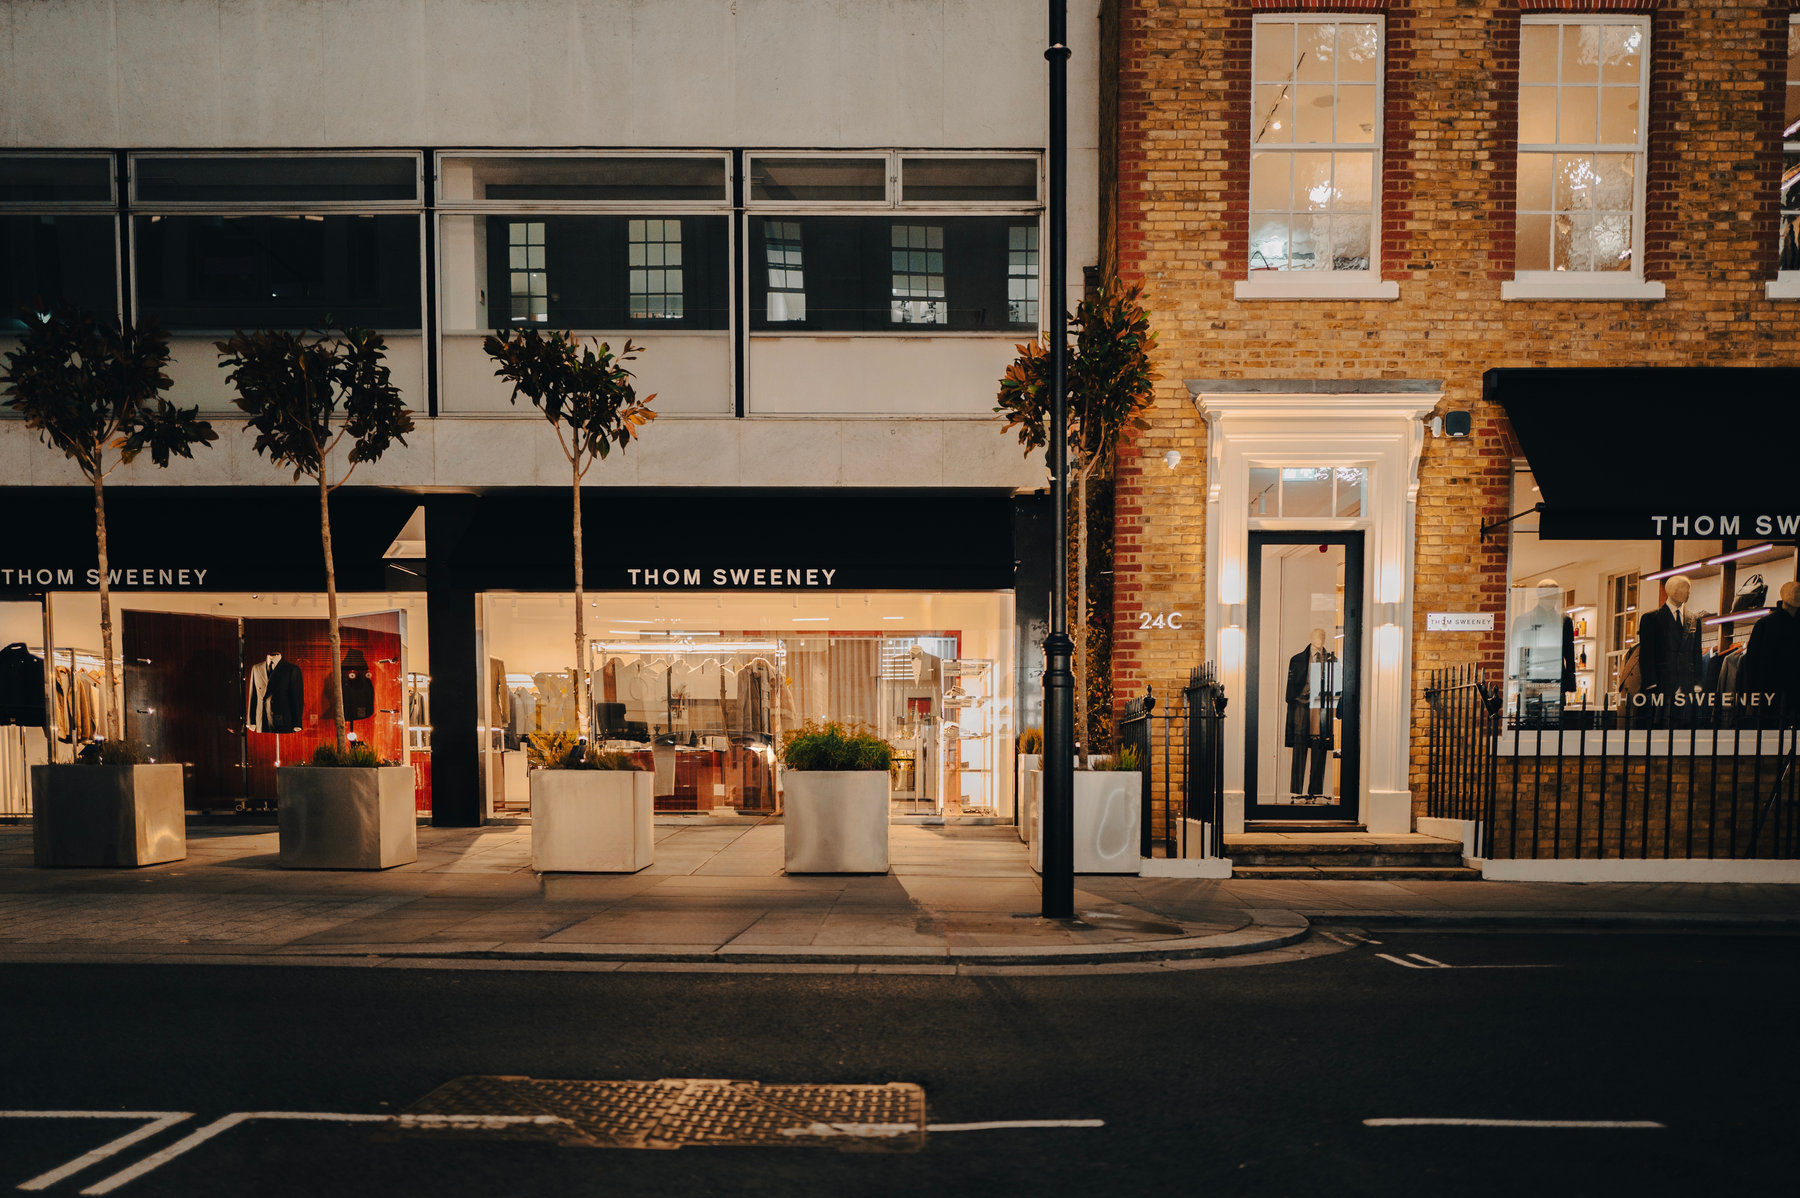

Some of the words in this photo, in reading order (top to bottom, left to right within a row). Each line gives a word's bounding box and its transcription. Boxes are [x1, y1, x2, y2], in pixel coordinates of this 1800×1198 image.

[1651, 515, 1740, 536] THOM
[1, 569, 74, 585] THOM
[86, 569, 207, 585] SWEENEY
[627, 569, 700, 585] THOM
[712, 568, 836, 585] SWEENEY
[1139, 612, 1182, 629] 24C
